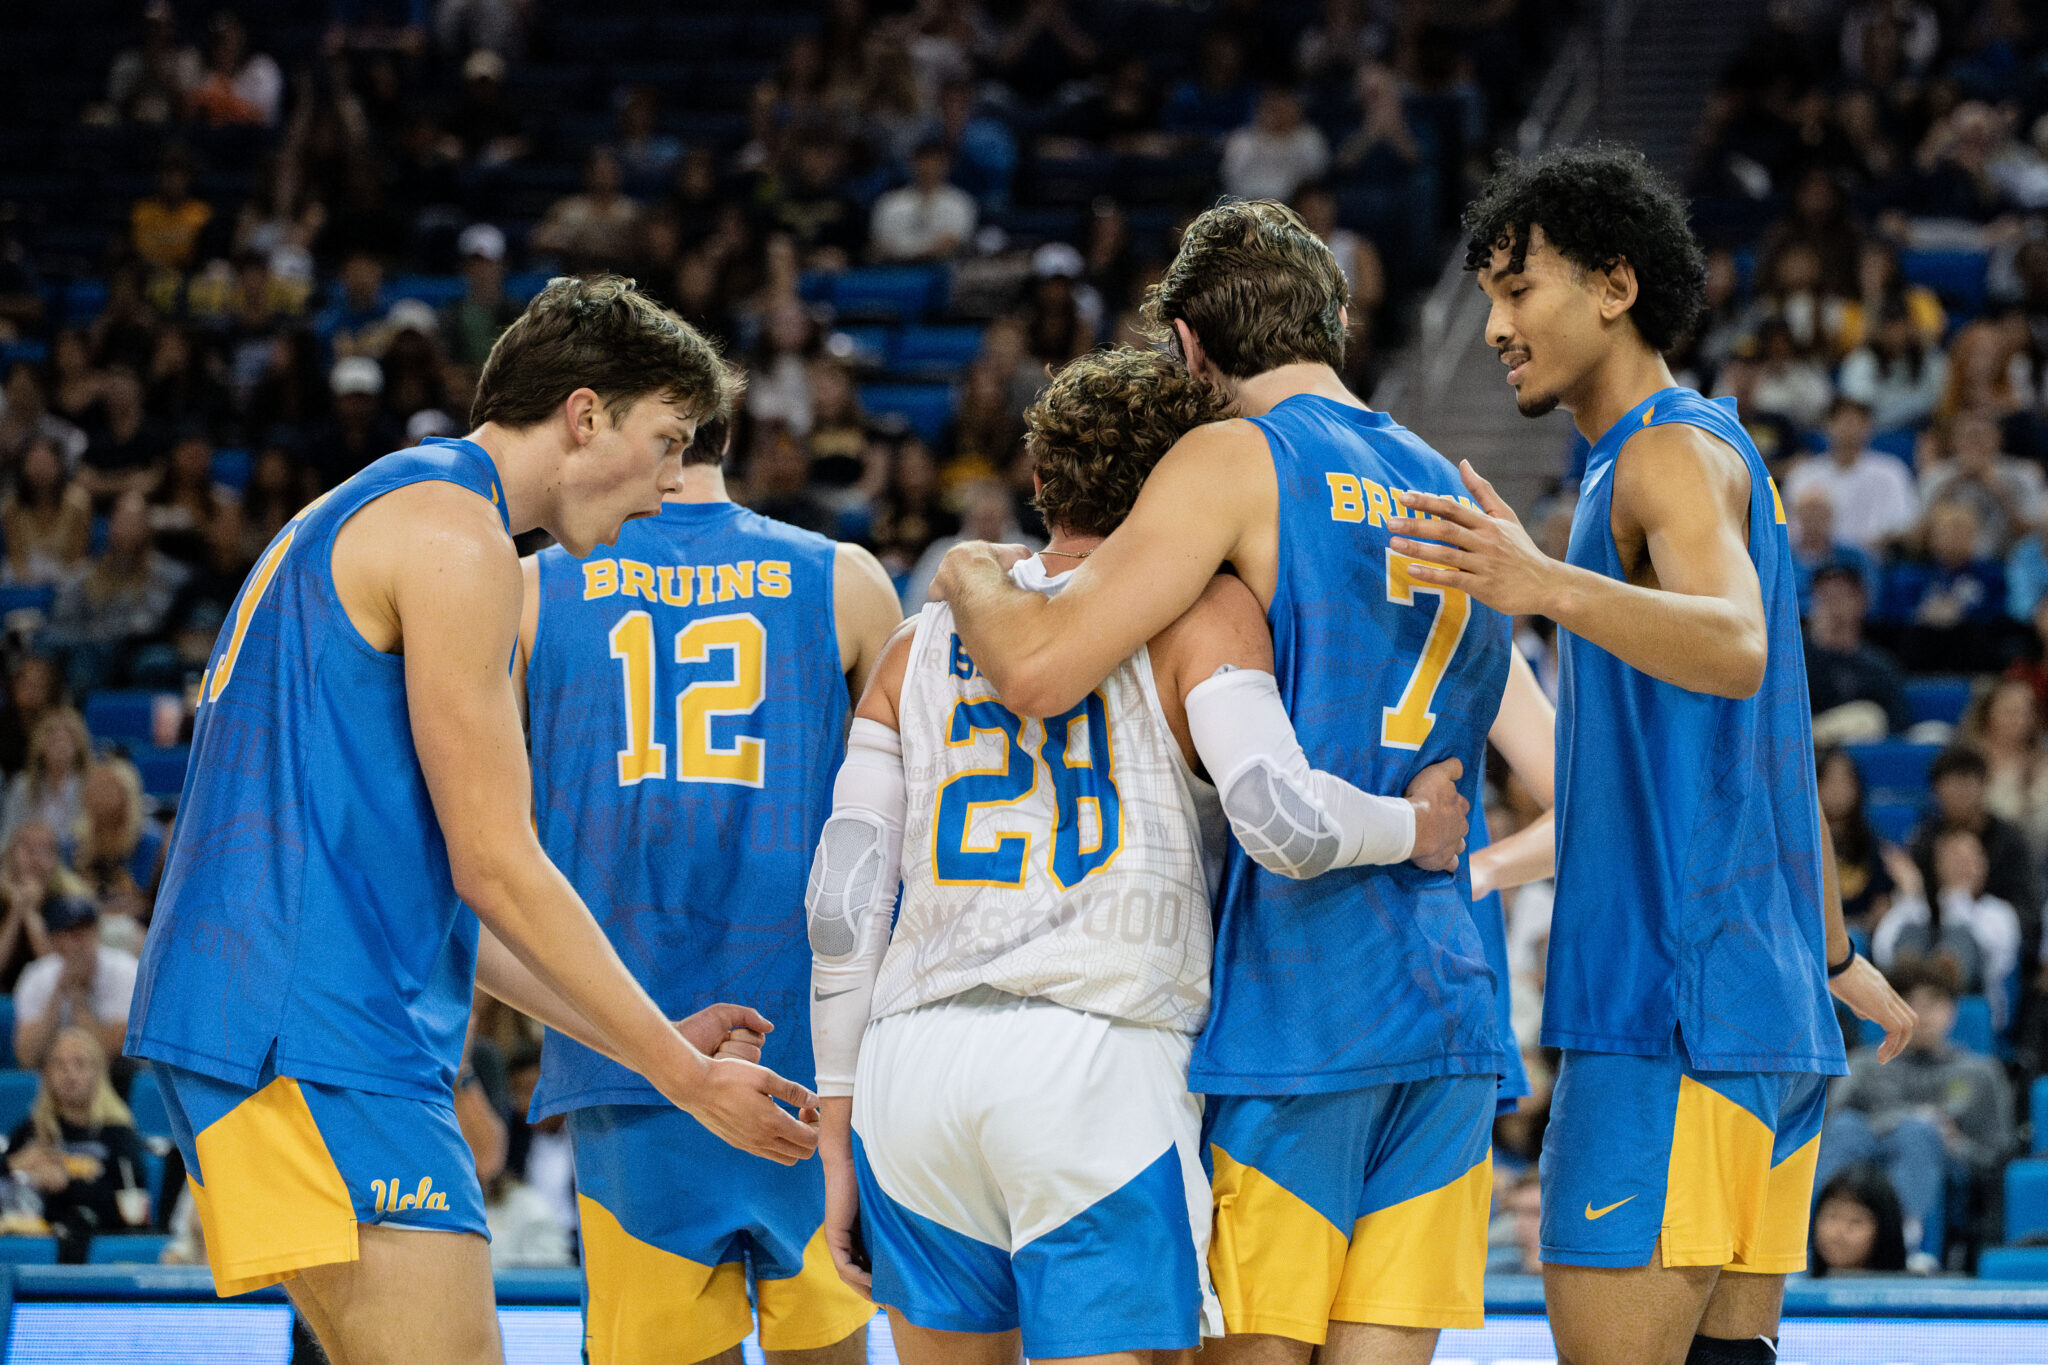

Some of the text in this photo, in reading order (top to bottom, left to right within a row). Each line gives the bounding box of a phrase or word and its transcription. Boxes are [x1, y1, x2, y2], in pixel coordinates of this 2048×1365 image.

[1325, 472, 1484, 528] BRU
[582, 558, 792, 607] BRUINS
[609, 610, 767, 789] 12
[1381, 547, 1471, 751] 7
[932, 687, 1125, 894] 28
[370, 1176, 450, 1213] Ucla
